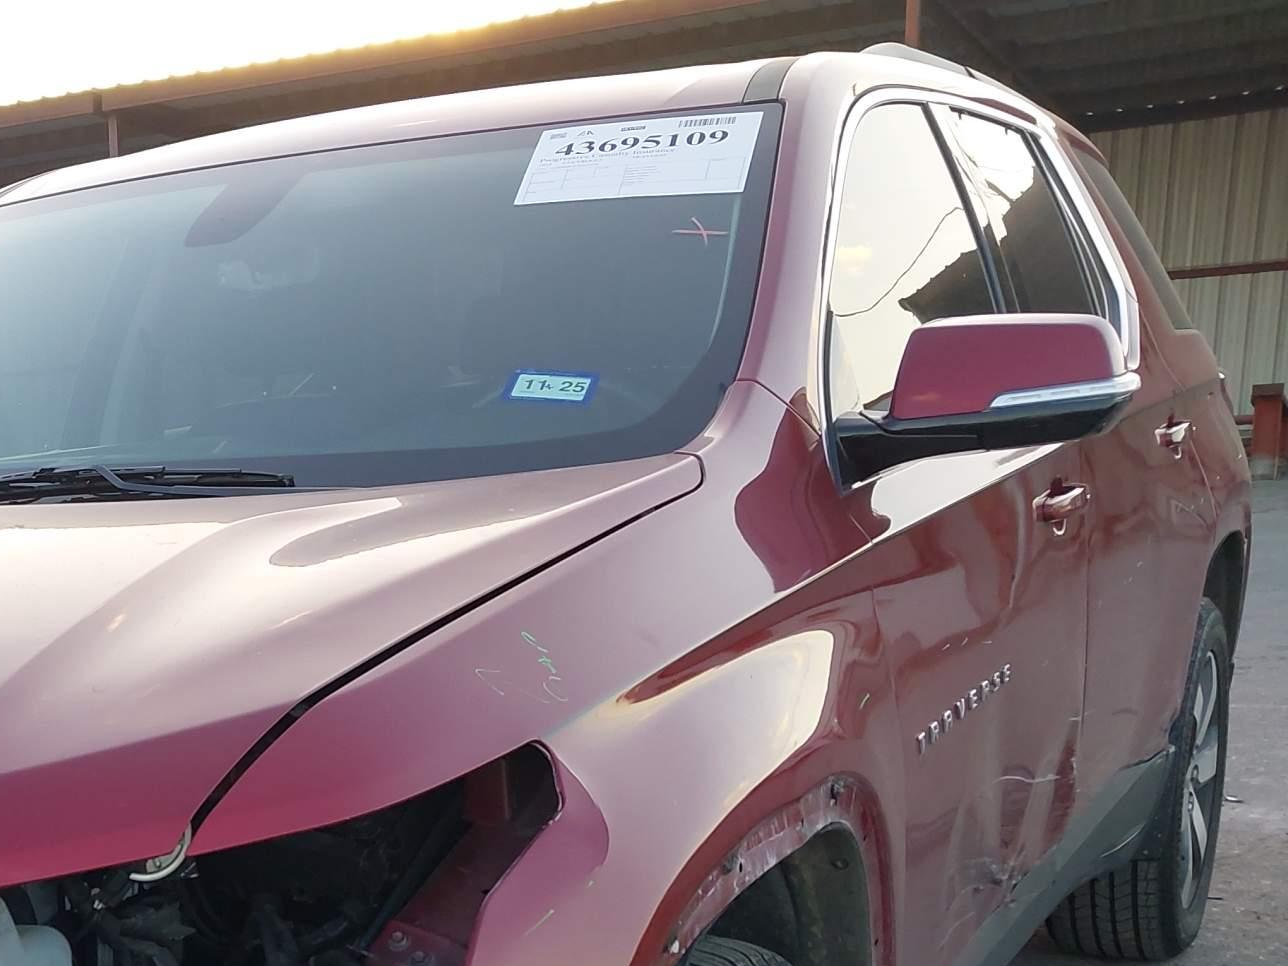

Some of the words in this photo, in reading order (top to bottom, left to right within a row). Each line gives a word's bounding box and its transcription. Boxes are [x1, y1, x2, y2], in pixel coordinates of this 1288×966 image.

[555, 130, 729, 156] 43695109
[525, 379, 548, 391] 11
[559, 380, 587, 393] 25
[915, 663, 1012, 756] TRAVERSE
